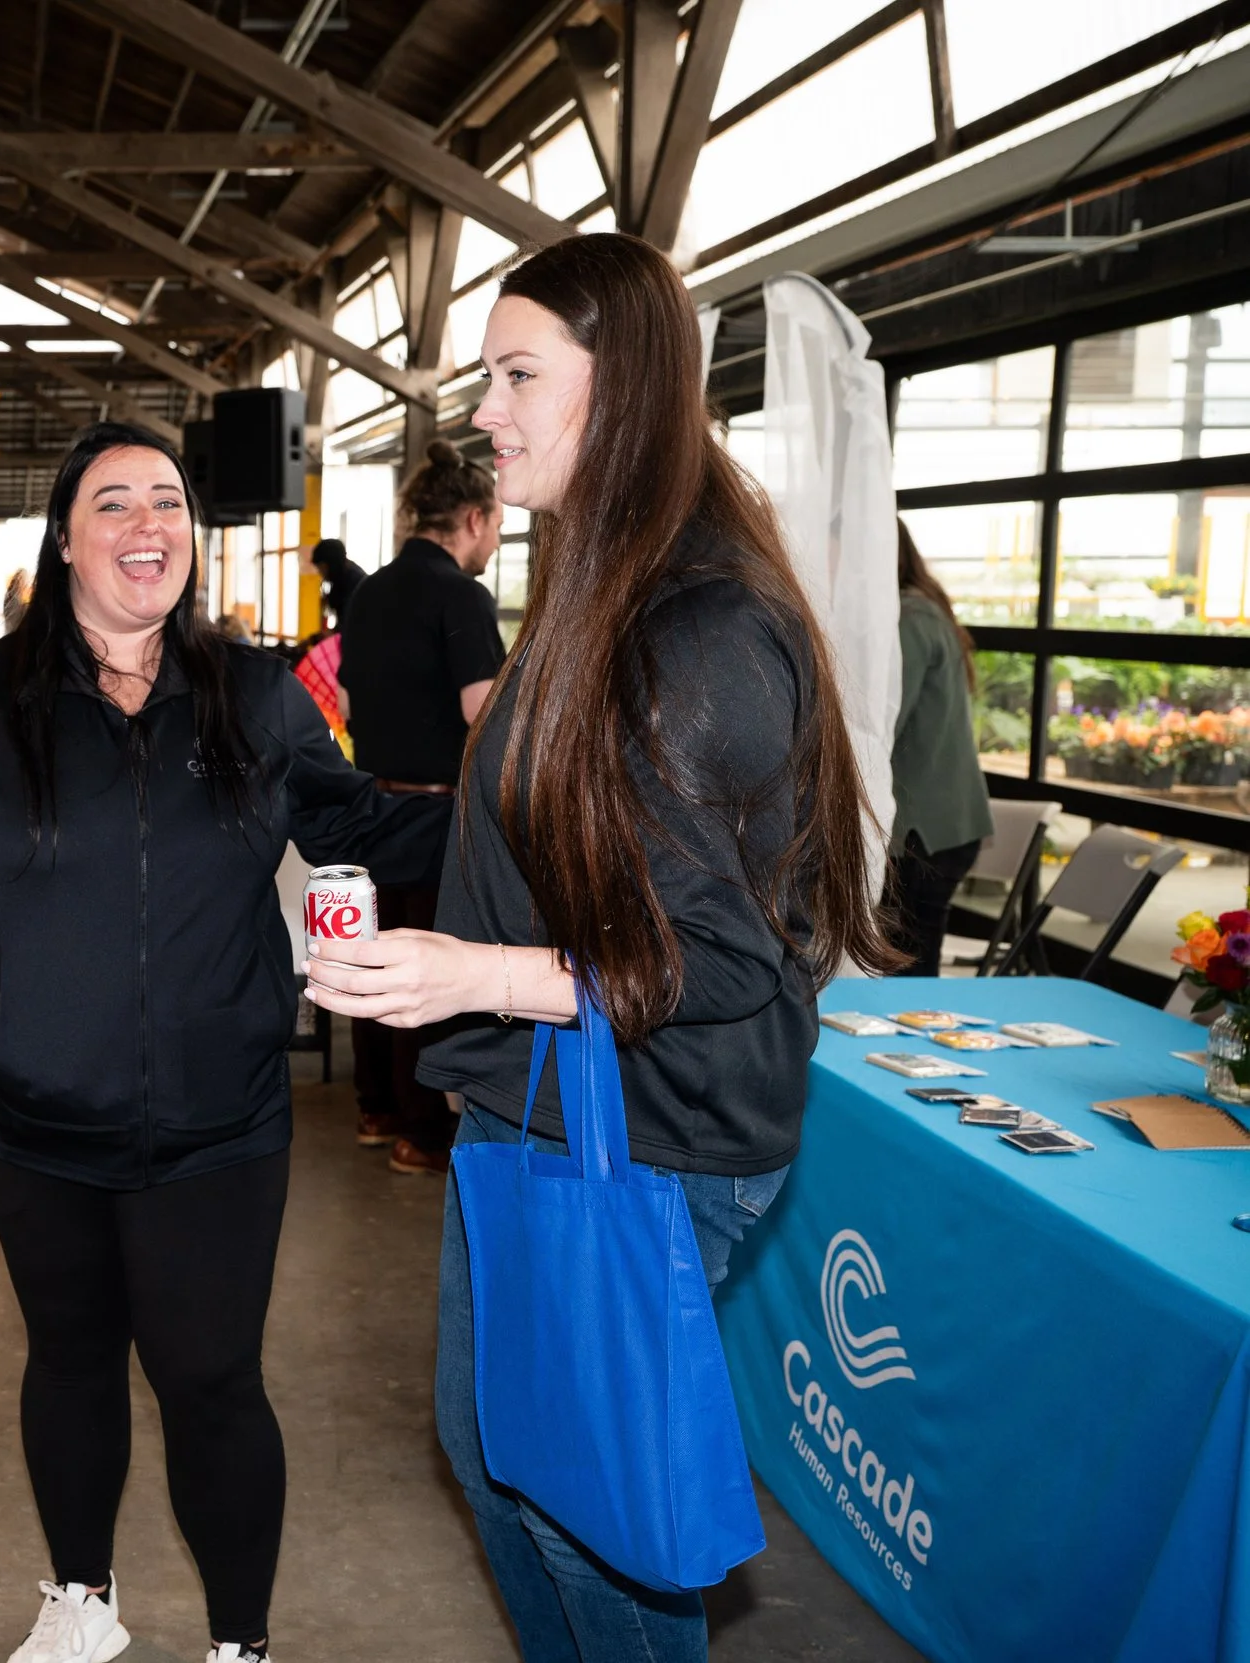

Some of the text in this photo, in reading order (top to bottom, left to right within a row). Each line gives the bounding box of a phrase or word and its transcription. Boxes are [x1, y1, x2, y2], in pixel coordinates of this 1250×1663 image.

[304, 892, 363, 940] ke
[318, 889, 351, 905] Diet
[783, 1340, 933, 1566] Cascade
[788, 1421, 914, 1592] Human Resources
